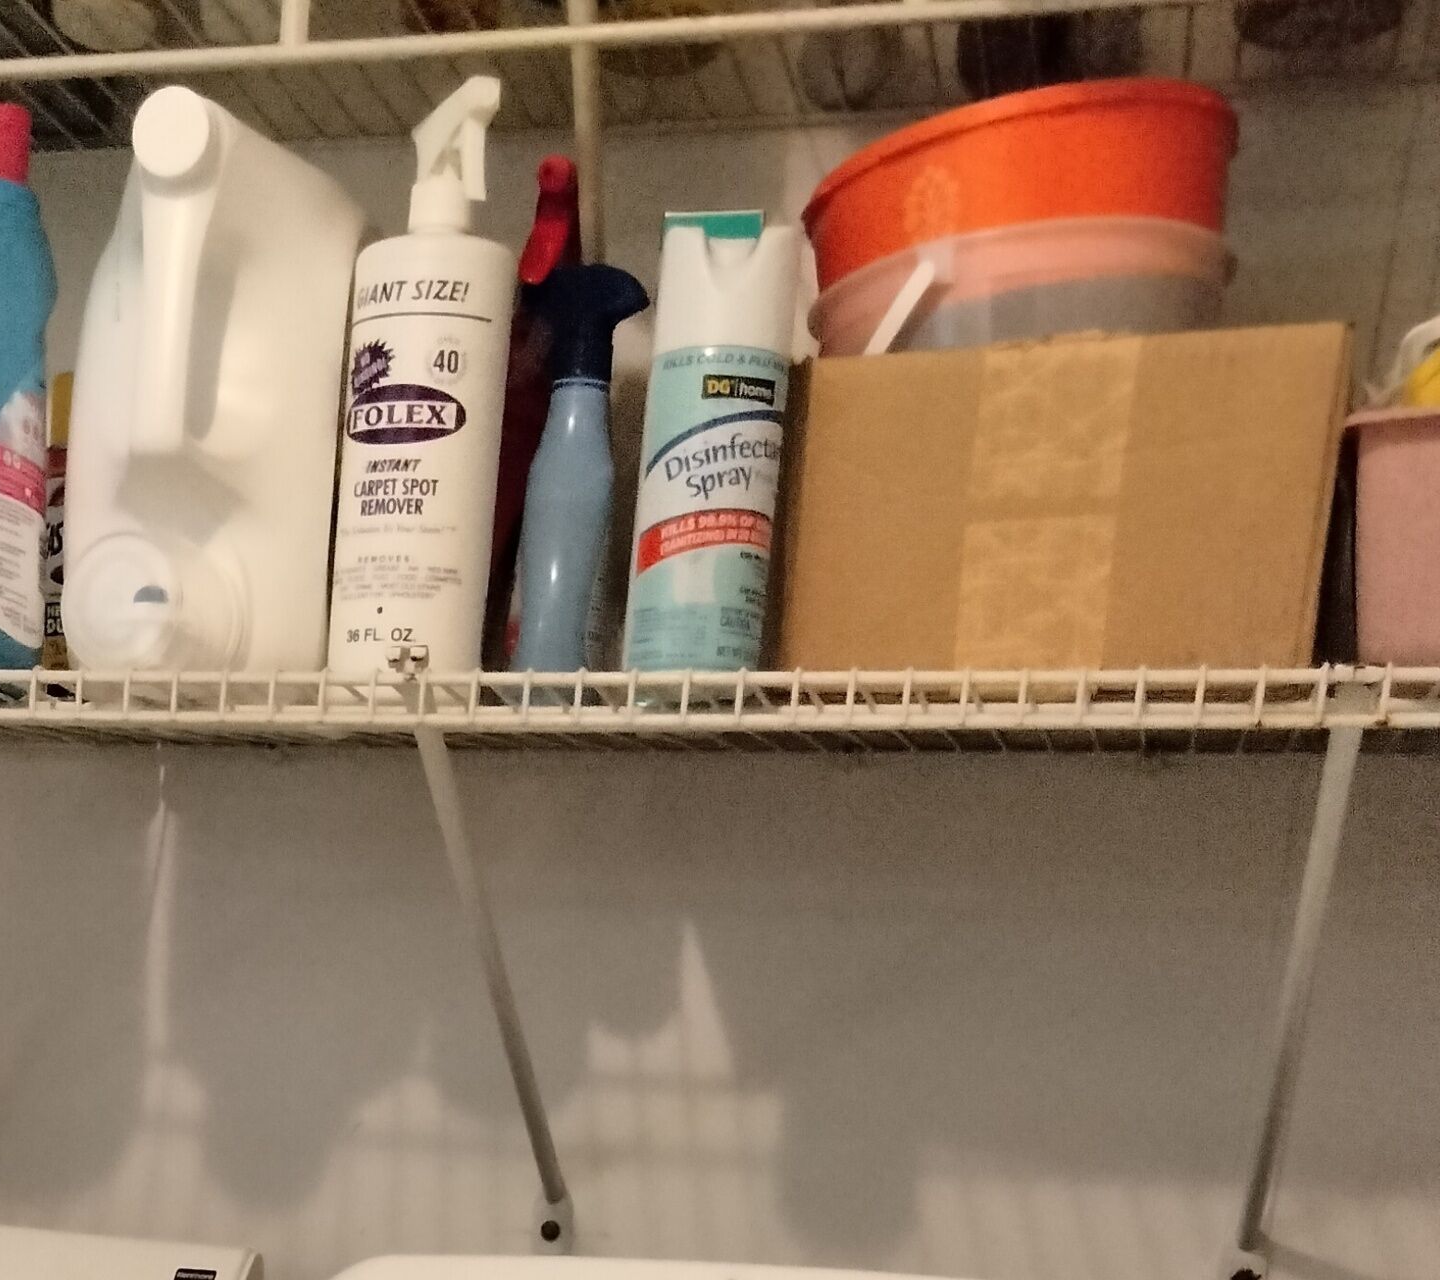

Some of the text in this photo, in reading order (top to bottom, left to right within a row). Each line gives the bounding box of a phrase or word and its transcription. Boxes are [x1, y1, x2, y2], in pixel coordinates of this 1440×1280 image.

[357, 279, 470, 309] GIANT SIZE!
[433, 349, 459, 374] 40
[707, 379, 773, 398] DG home
[352, 404, 447, 430] FOLEX
[366, 458, 422, 474] INSTANT
[354, 479, 439, 497] CARPET SPOT
[686, 467, 751, 500] Spray
[360, 499, 424, 516] REMOVER
[346, 628, 359, 643] 36
